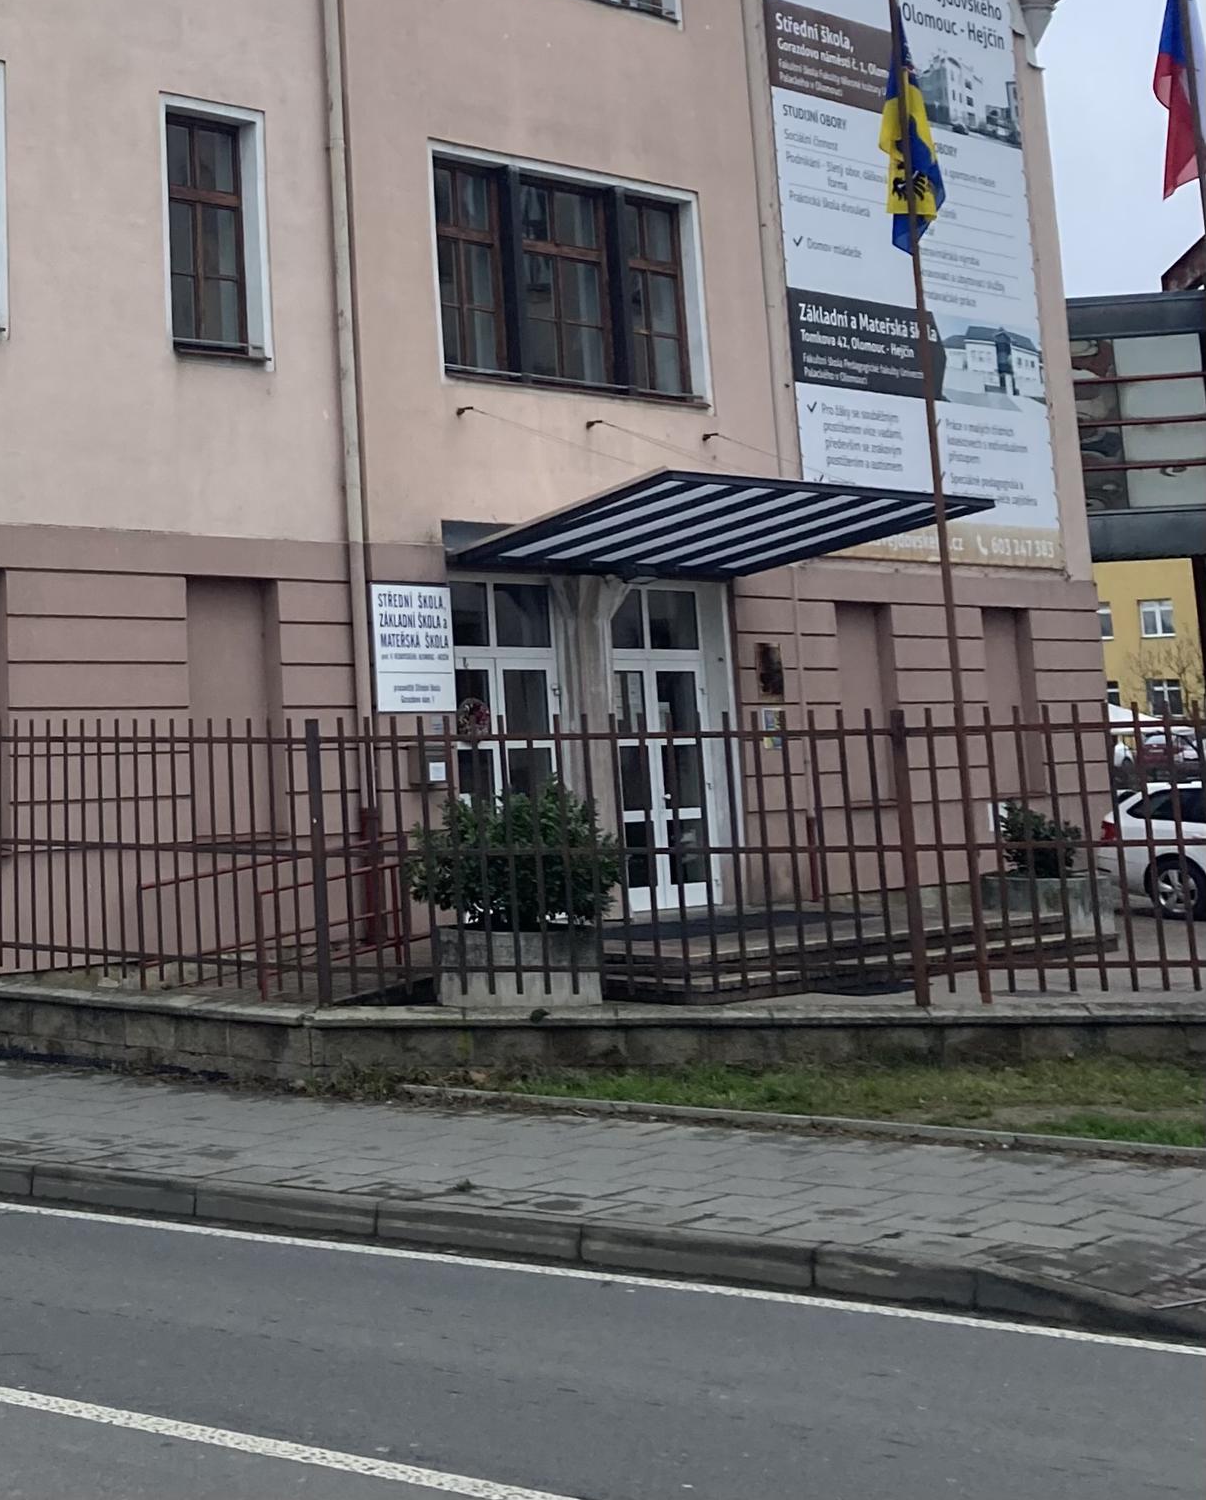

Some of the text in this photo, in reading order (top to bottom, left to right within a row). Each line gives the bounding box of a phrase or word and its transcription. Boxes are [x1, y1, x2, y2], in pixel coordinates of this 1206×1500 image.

[902, 2, 958, 36] Olomouc
[775, 12, 854, 53] Střední škola,
[777, 37, 819, 60] Gorazdovo
[819, 113, 847, 130] OBORY
[798, 302, 848, 328] Základní
[850, 315, 857, 329] a
[858, 312, 908, 337] Mateřská
[799, 328, 836, 346] Tomkova
[837, 335, 850, 350] 42,
[850, 337, 886, 354] Olomouc
[378, 591, 447, 611] STŘEDNÍ ŠKOLA,
[379, 611, 416, 628] ZÁKLADNÍ
[418, 611, 441, 629] ŠKOLA
[380, 631, 449, 649] MATEŘSKÁ ŠKOLA
